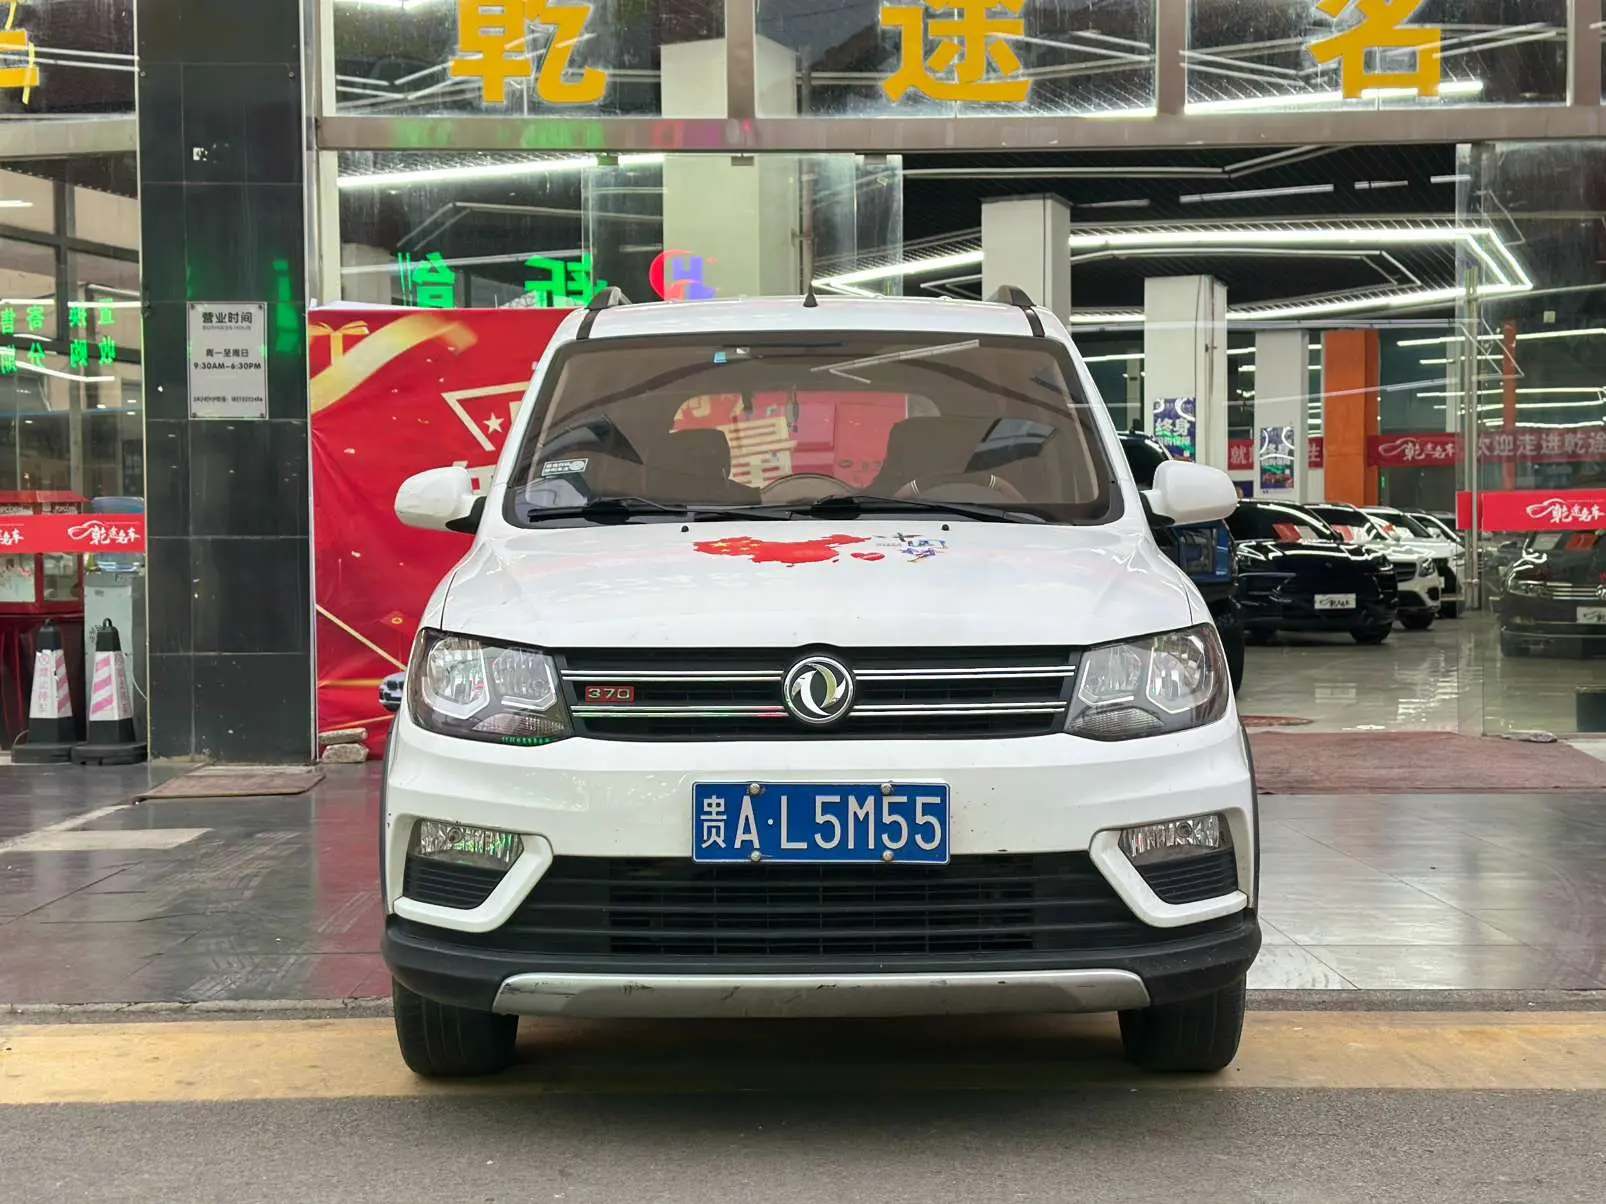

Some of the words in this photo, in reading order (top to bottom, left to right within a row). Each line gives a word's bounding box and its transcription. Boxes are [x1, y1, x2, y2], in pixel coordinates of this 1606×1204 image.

[880, 0, 1032, 103] 途
[202, 311, 253, 324] 营业时间
[206, 348, 249, 358] 周一至周日
[588, 687, 631, 700] 370
[700, 794, 942, 851] 贵A·L5M55
